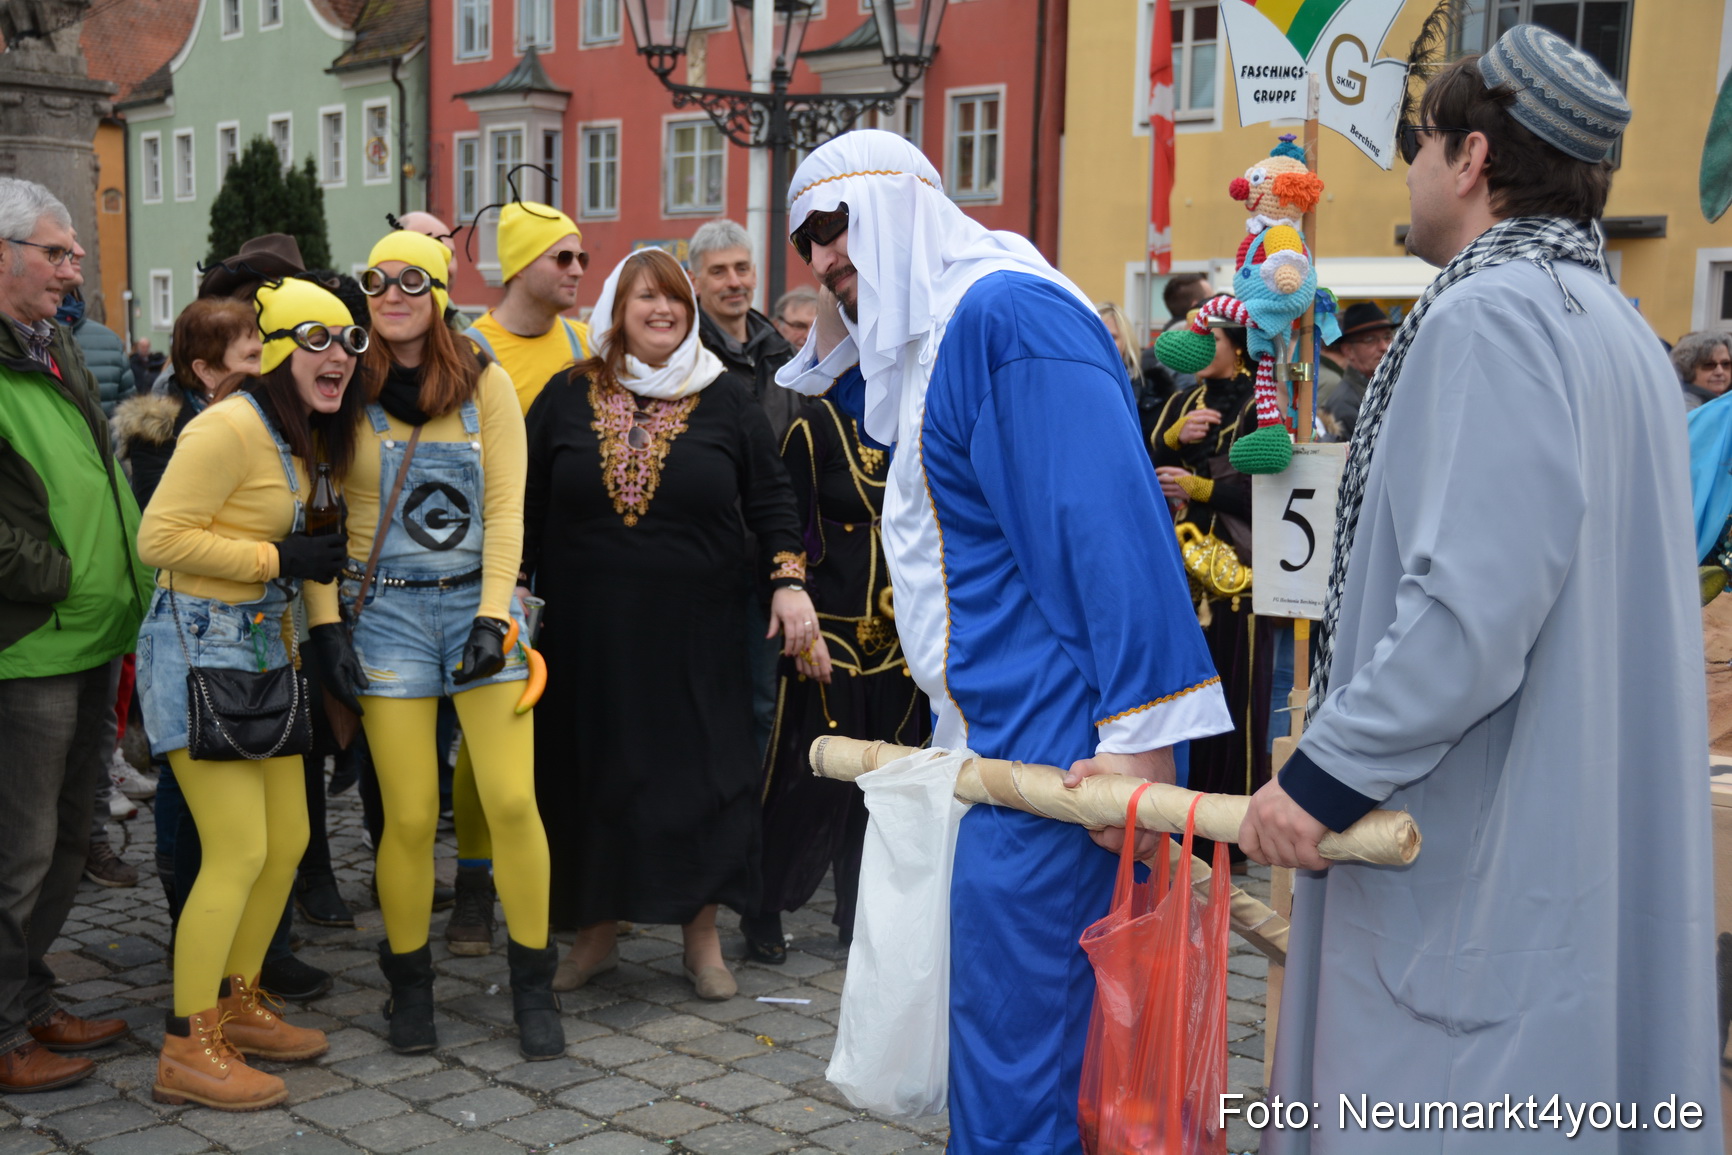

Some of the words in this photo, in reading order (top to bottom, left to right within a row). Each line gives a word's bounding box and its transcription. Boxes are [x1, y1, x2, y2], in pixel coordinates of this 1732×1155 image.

[1241, 65, 1308, 79] FASCHINGS-
[1336, 75, 1356, 90] SKMJ
[1253, 89, 1296, 103] GRUPPE
[1350, 124, 1380, 157] Berching
[1279, 488, 1316, 572] 5
